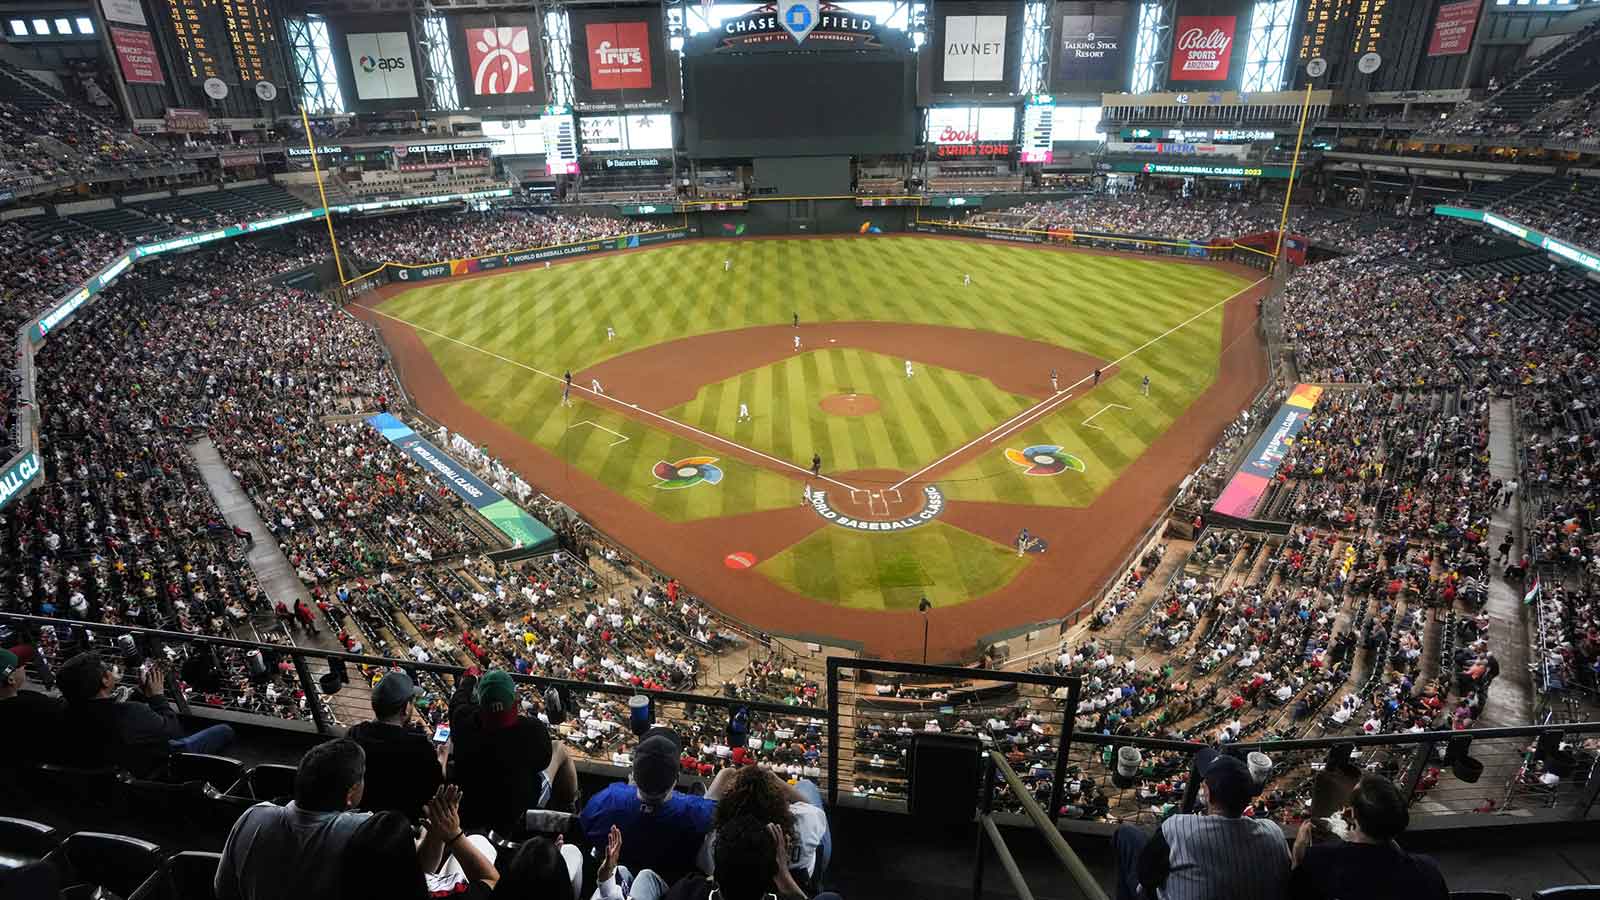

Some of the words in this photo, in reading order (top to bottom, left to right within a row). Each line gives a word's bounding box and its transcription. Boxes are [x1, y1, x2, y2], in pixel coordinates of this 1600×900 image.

[726, 18, 775, 34] CHASE
[823, 16, 871, 30] FIELD
[948, 43, 1001, 55] AVNET
[1178, 28, 1231, 55] Bally
[595, 40, 642, 65] fry's
[1188, 51, 1216, 60] SPORTS
[378, 57, 405, 72] aps
[1176, 95, 1189, 103] 42
[940, 125, 978, 142] Coors
[937, 145, 977, 156] STRIKE
[978, 144, 1009, 155] ZONE
[1180, 166, 1213, 174] BASEBALL
[514, 254, 535, 262] WORLD
[536, 249, 563, 259] BASEBALL
[564, 246, 586, 254] CLASSIC
[399, 269, 409, 280] G
[812, 490, 836, 519] WORLD
[837, 516, 921, 530] BASEBALL
[919, 486, 941, 519] CLASSIC
